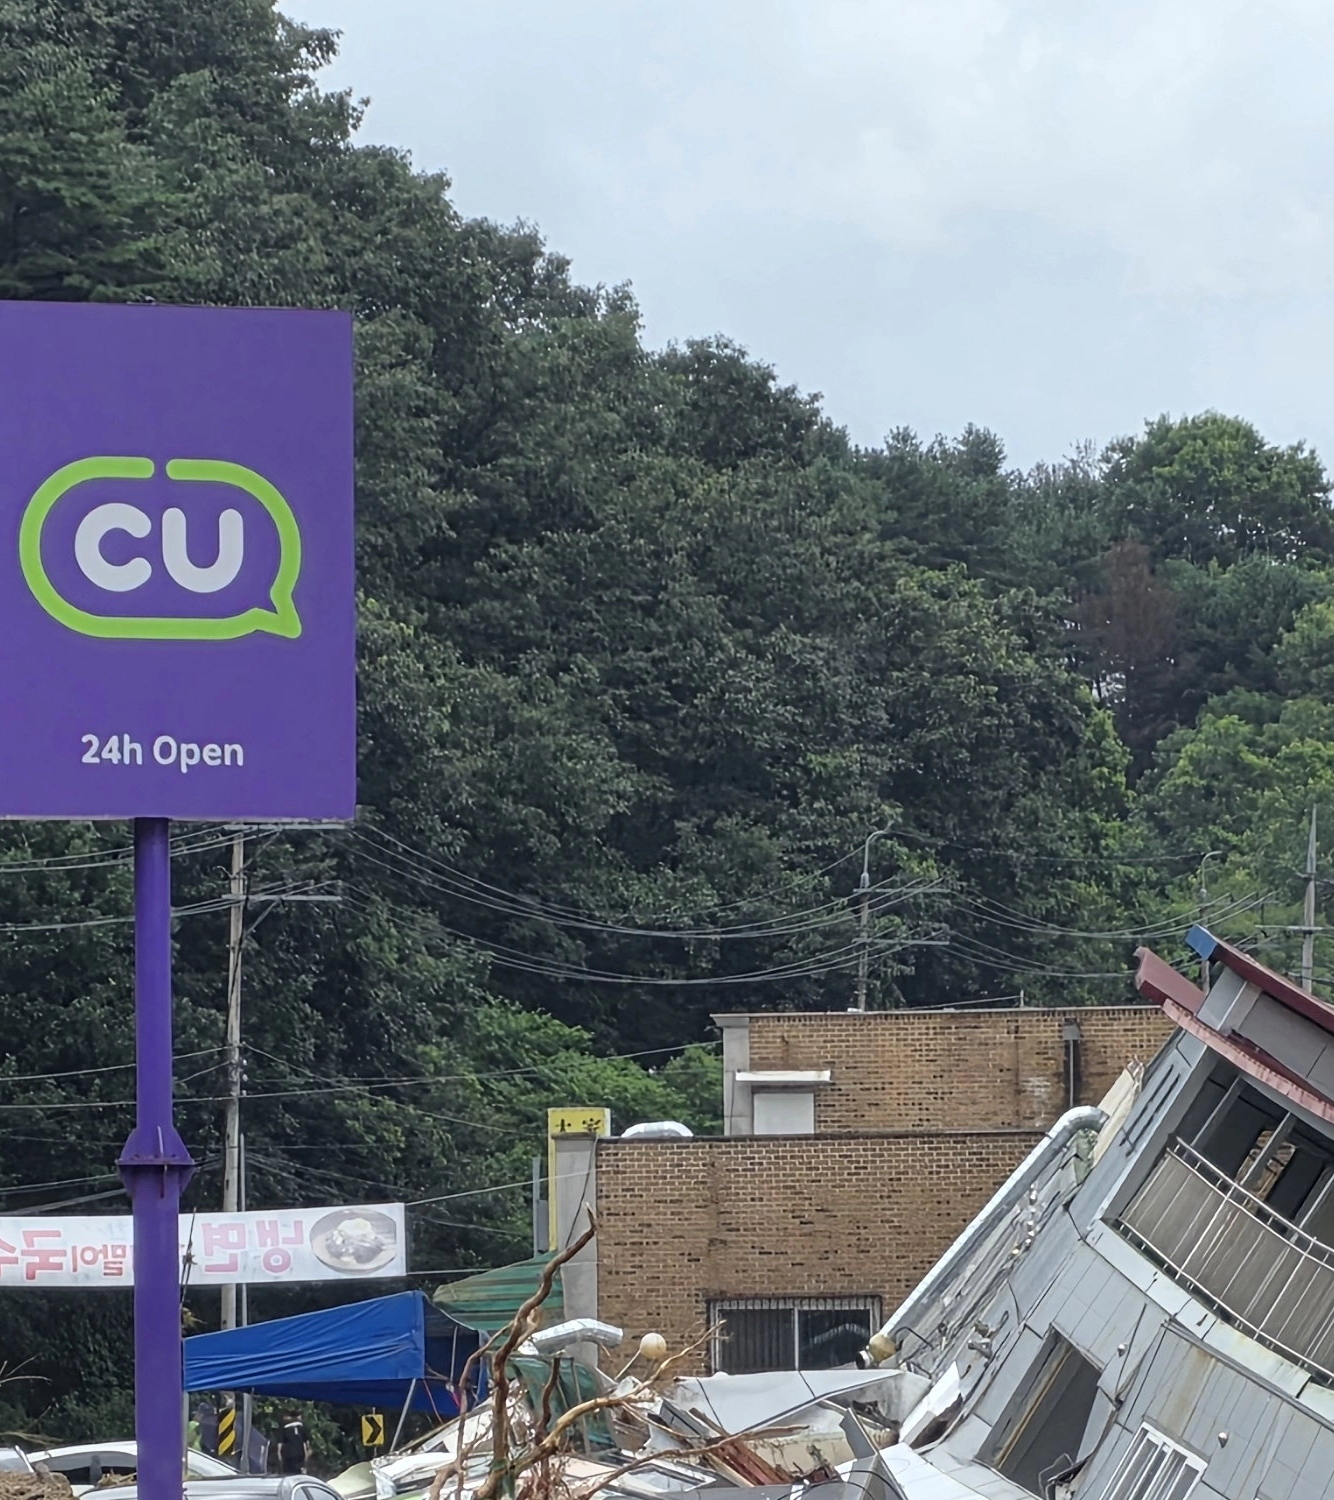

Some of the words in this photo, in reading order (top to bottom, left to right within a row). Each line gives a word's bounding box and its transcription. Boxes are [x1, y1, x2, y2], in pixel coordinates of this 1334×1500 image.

[75, 503, 244, 593] CU
[81, 734, 143, 765] 24h
[153, 735, 244, 774] Open
